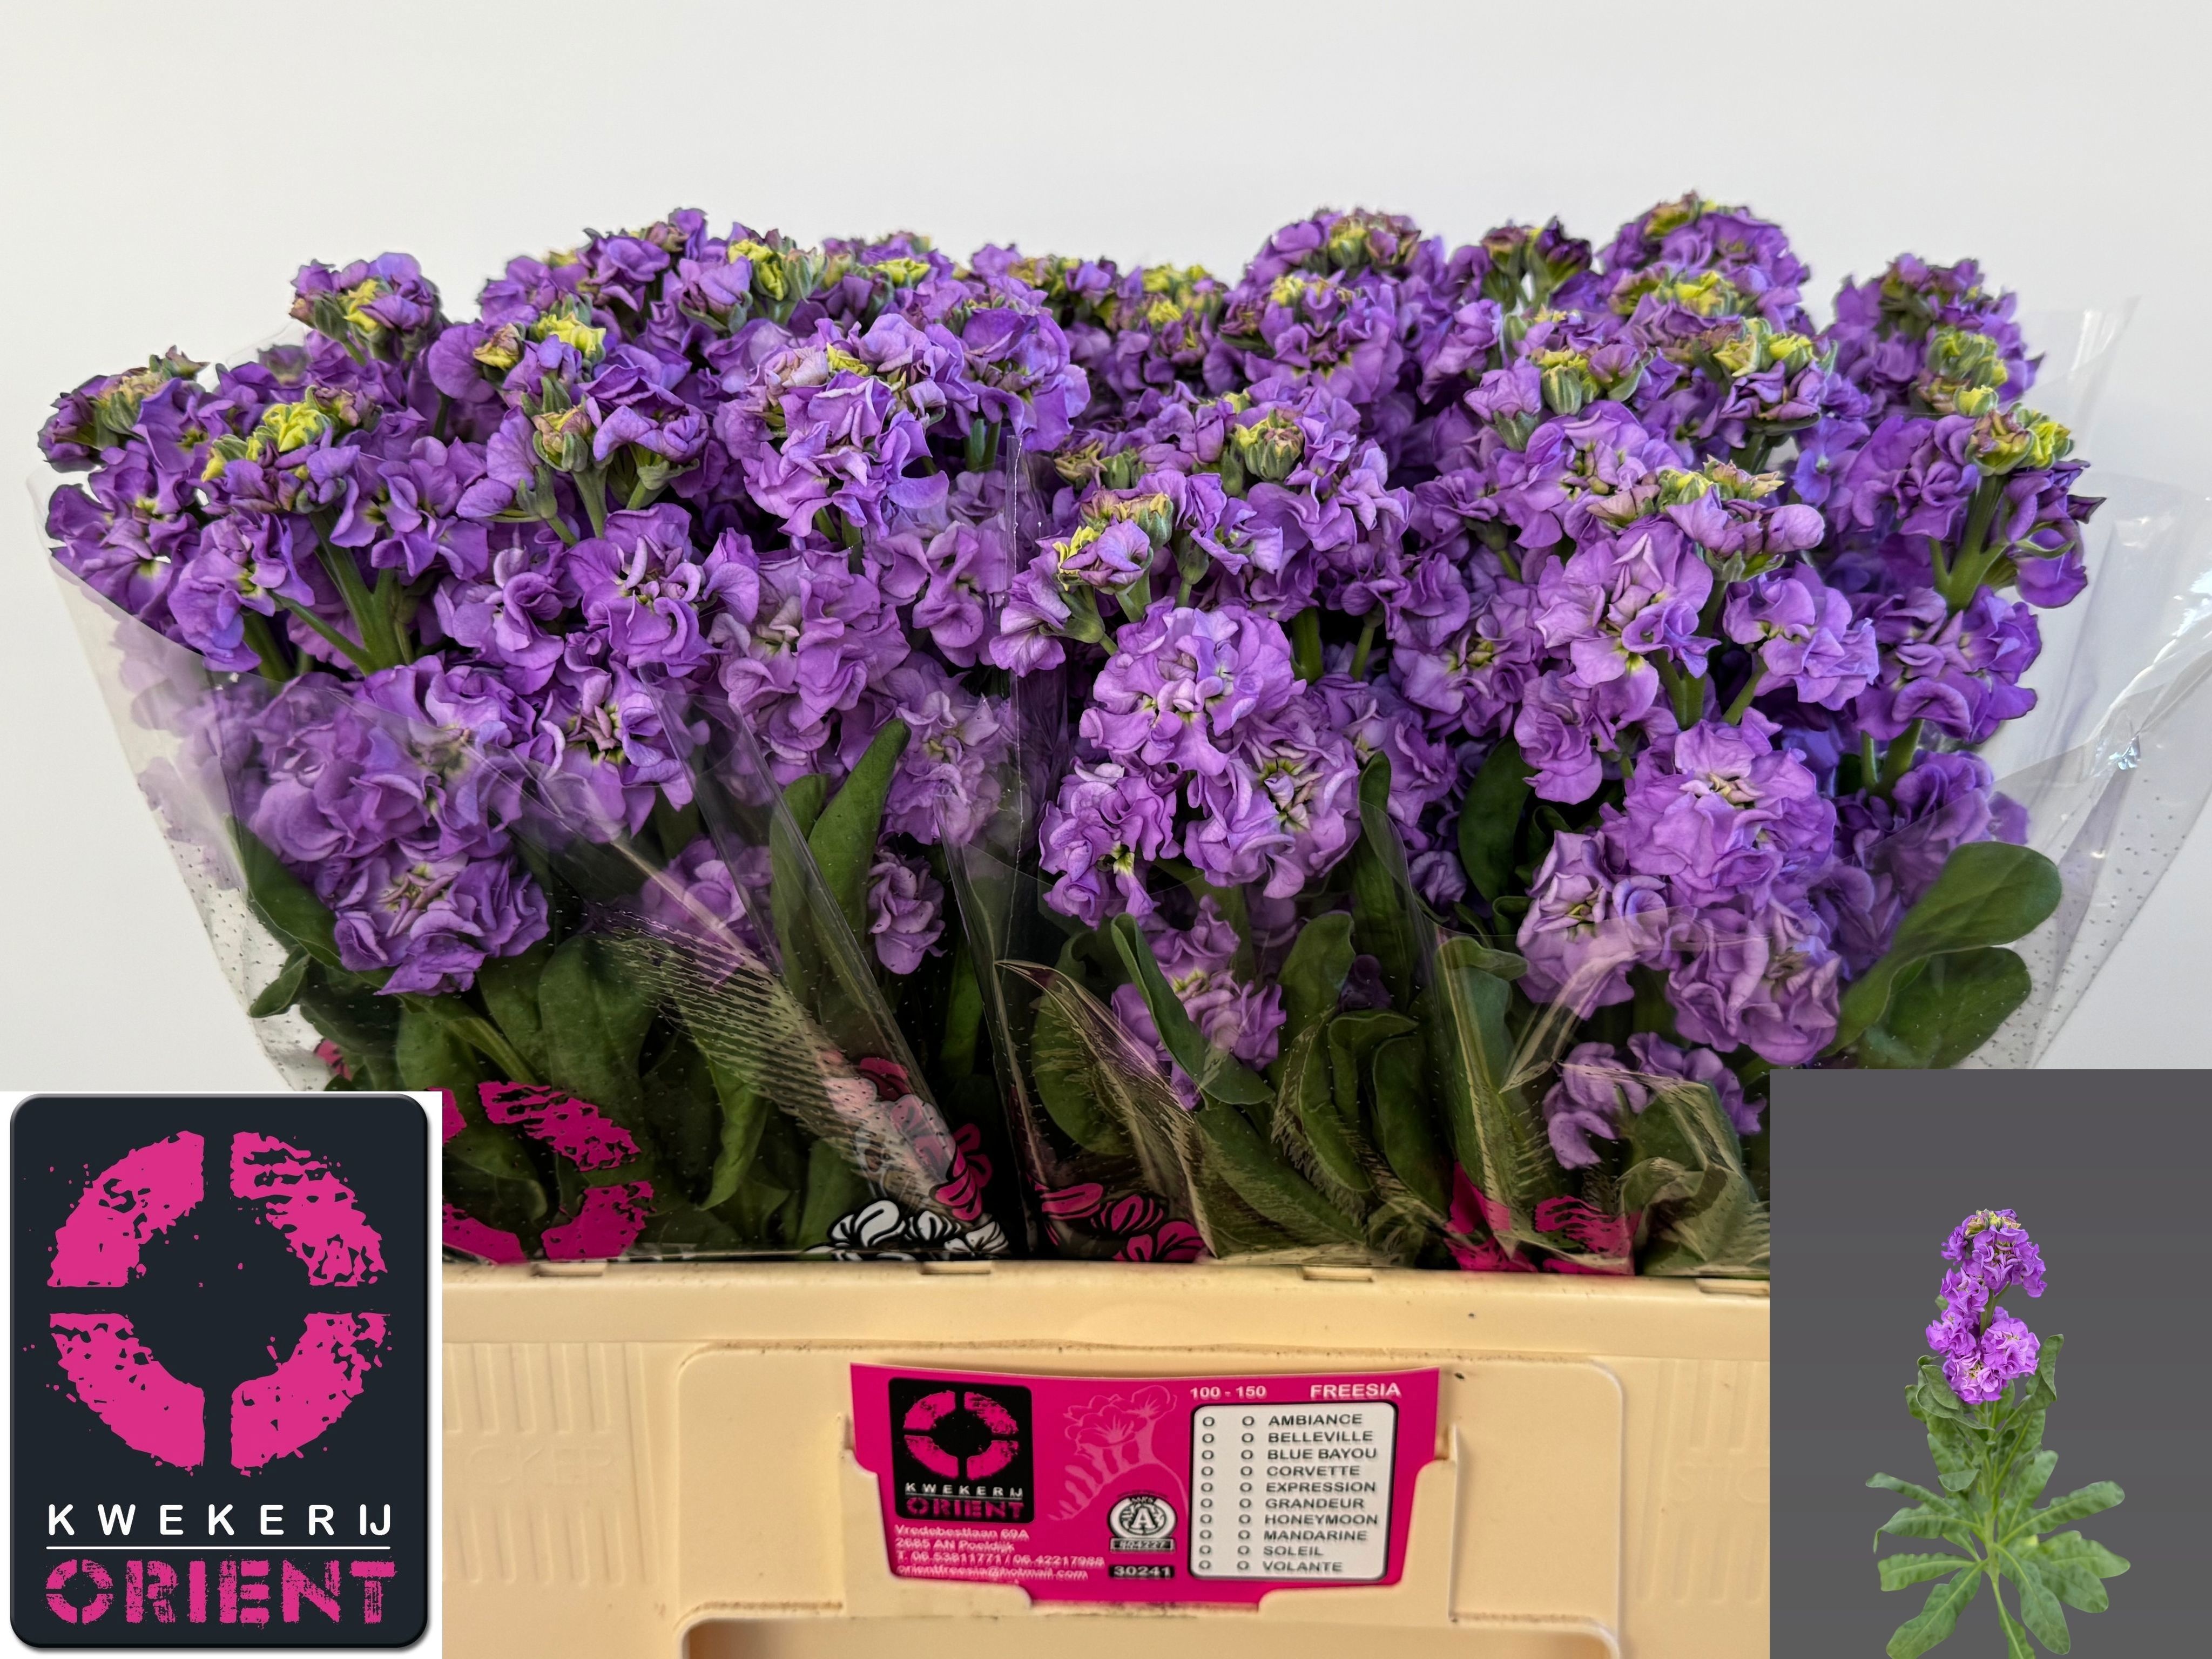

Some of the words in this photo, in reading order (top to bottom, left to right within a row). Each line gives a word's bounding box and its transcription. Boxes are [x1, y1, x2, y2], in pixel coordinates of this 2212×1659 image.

[1190, 1386, 1222, 1399] 100
[1236, 1386, 1267, 1398] 150
[1310, 1383, 1402, 1399] FREESIA
[1268, 1414, 1364, 1426] AMBIANCE
[1267, 1431, 1373, 1442] BELLEVILLE
[1267, 1448, 1313, 1460] BLUE
[1318, 1448, 1377, 1459] BAYOU
[1266, 1466, 1360, 1476] CORVETTE
[905, 1482, 1023, 1497] KWEKERIJ
[1266, 1482, 1376, 1493] EXPRESSION
[906, 1497, 1024, 1518] ORIENT
[1265, 1498, 1364, 1509] GRANDEUR
[1264, 1514, 1378, 1525] HONEYMOON
[1264, 1530, 1367, 1541] MANDARINE
[933, 1539, 955, 1551] AN
[1263, 1546, 1324, 1556] SOLEIL
[1114, 1566, 1171, 1578] 30241
[1262, 1561, 1343, 1572] VOLANTE
